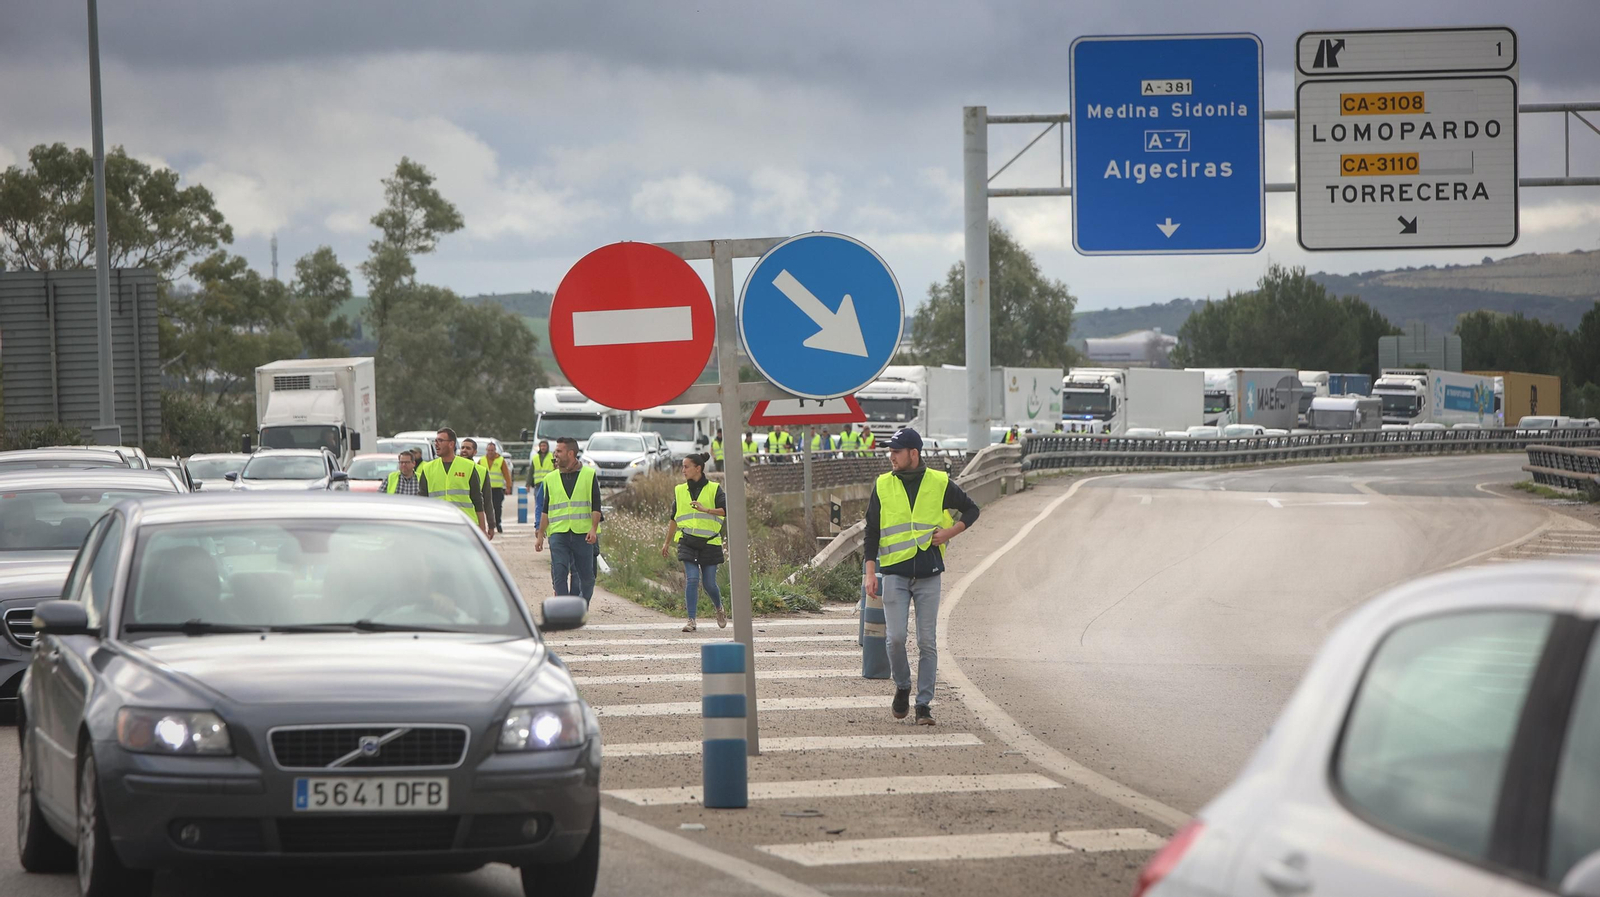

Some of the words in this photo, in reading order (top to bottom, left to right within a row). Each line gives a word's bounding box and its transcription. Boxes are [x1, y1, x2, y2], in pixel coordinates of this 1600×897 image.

[1495, 40, 1502, 58] 1
[1144, 81, 1190, 94] A-381
[1088, 103, 1158, 118] Medina
[1172, 102, 1248, 117] Sidonia
[1342, 94, 1424, 113] CA-3108
[1312, 119, 1502, 143] LOMOPARDO
[1148, 133, 1188, 149] A-7
[1104, 159, 1233, 183] Algeciras
[1342, 155, 1419, 174] CA-3110
[1325, 181, 1490, 204] TORRECERA
[313, 782, 384, 806] 5641
[395, 782, 443, 806] DFB
